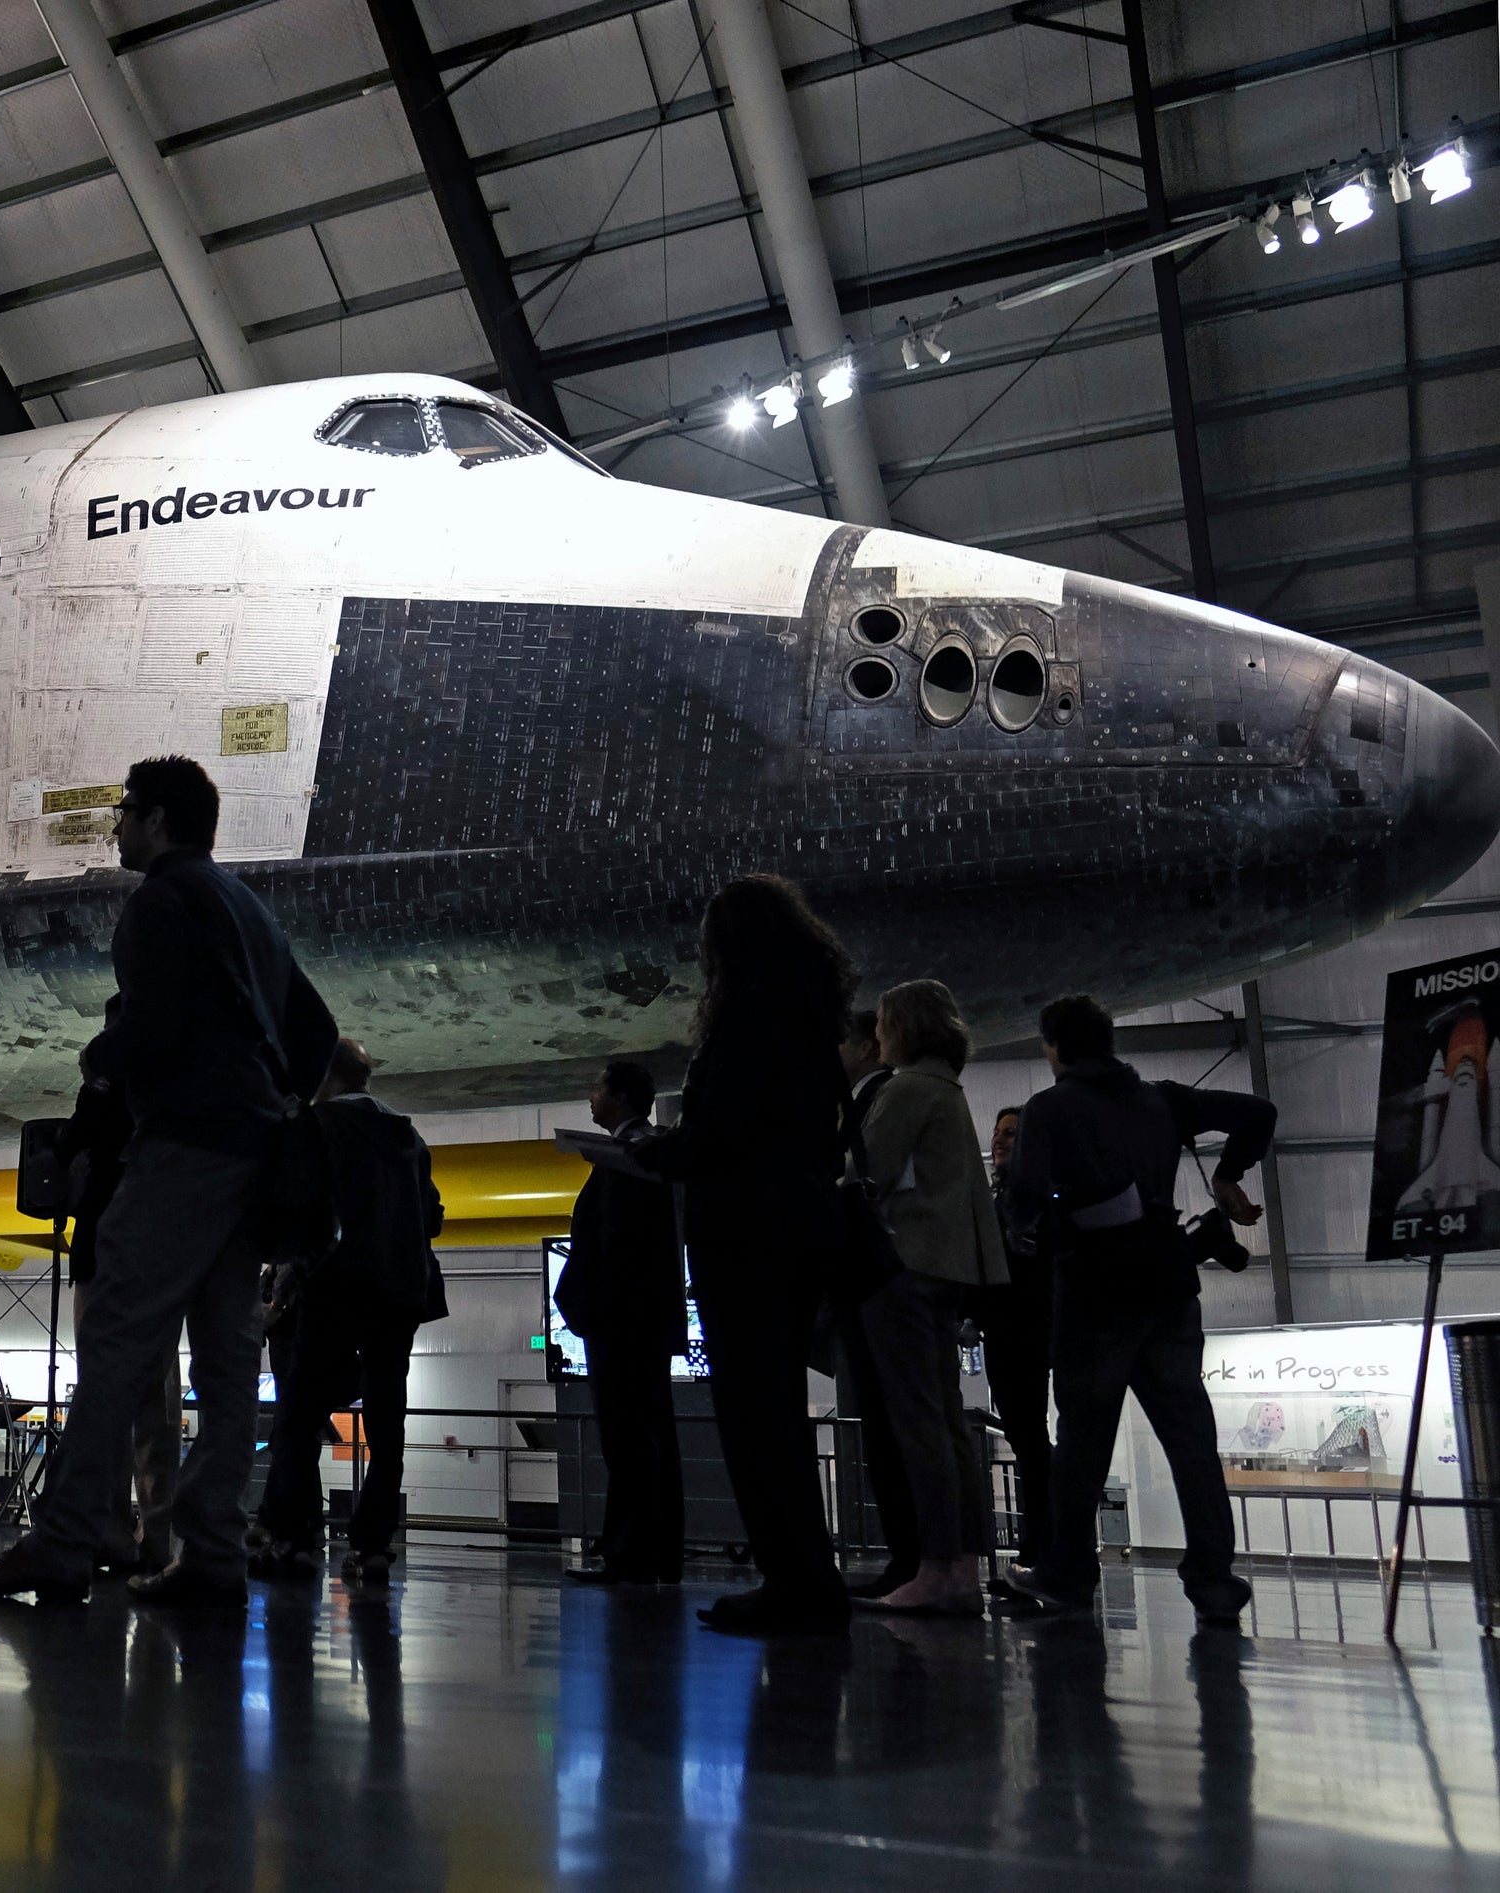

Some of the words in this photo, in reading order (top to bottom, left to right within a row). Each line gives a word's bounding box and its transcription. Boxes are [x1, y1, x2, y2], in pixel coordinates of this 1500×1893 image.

[87, 487, 376, 541] Endeavour
[1415, 961, 1500, 998] MISSIO
[1200, 1359, 1236, 1381] ork
[1249, 1365, 1265, 1380] in
[1276, 1356, 1390, 1391] Progress
